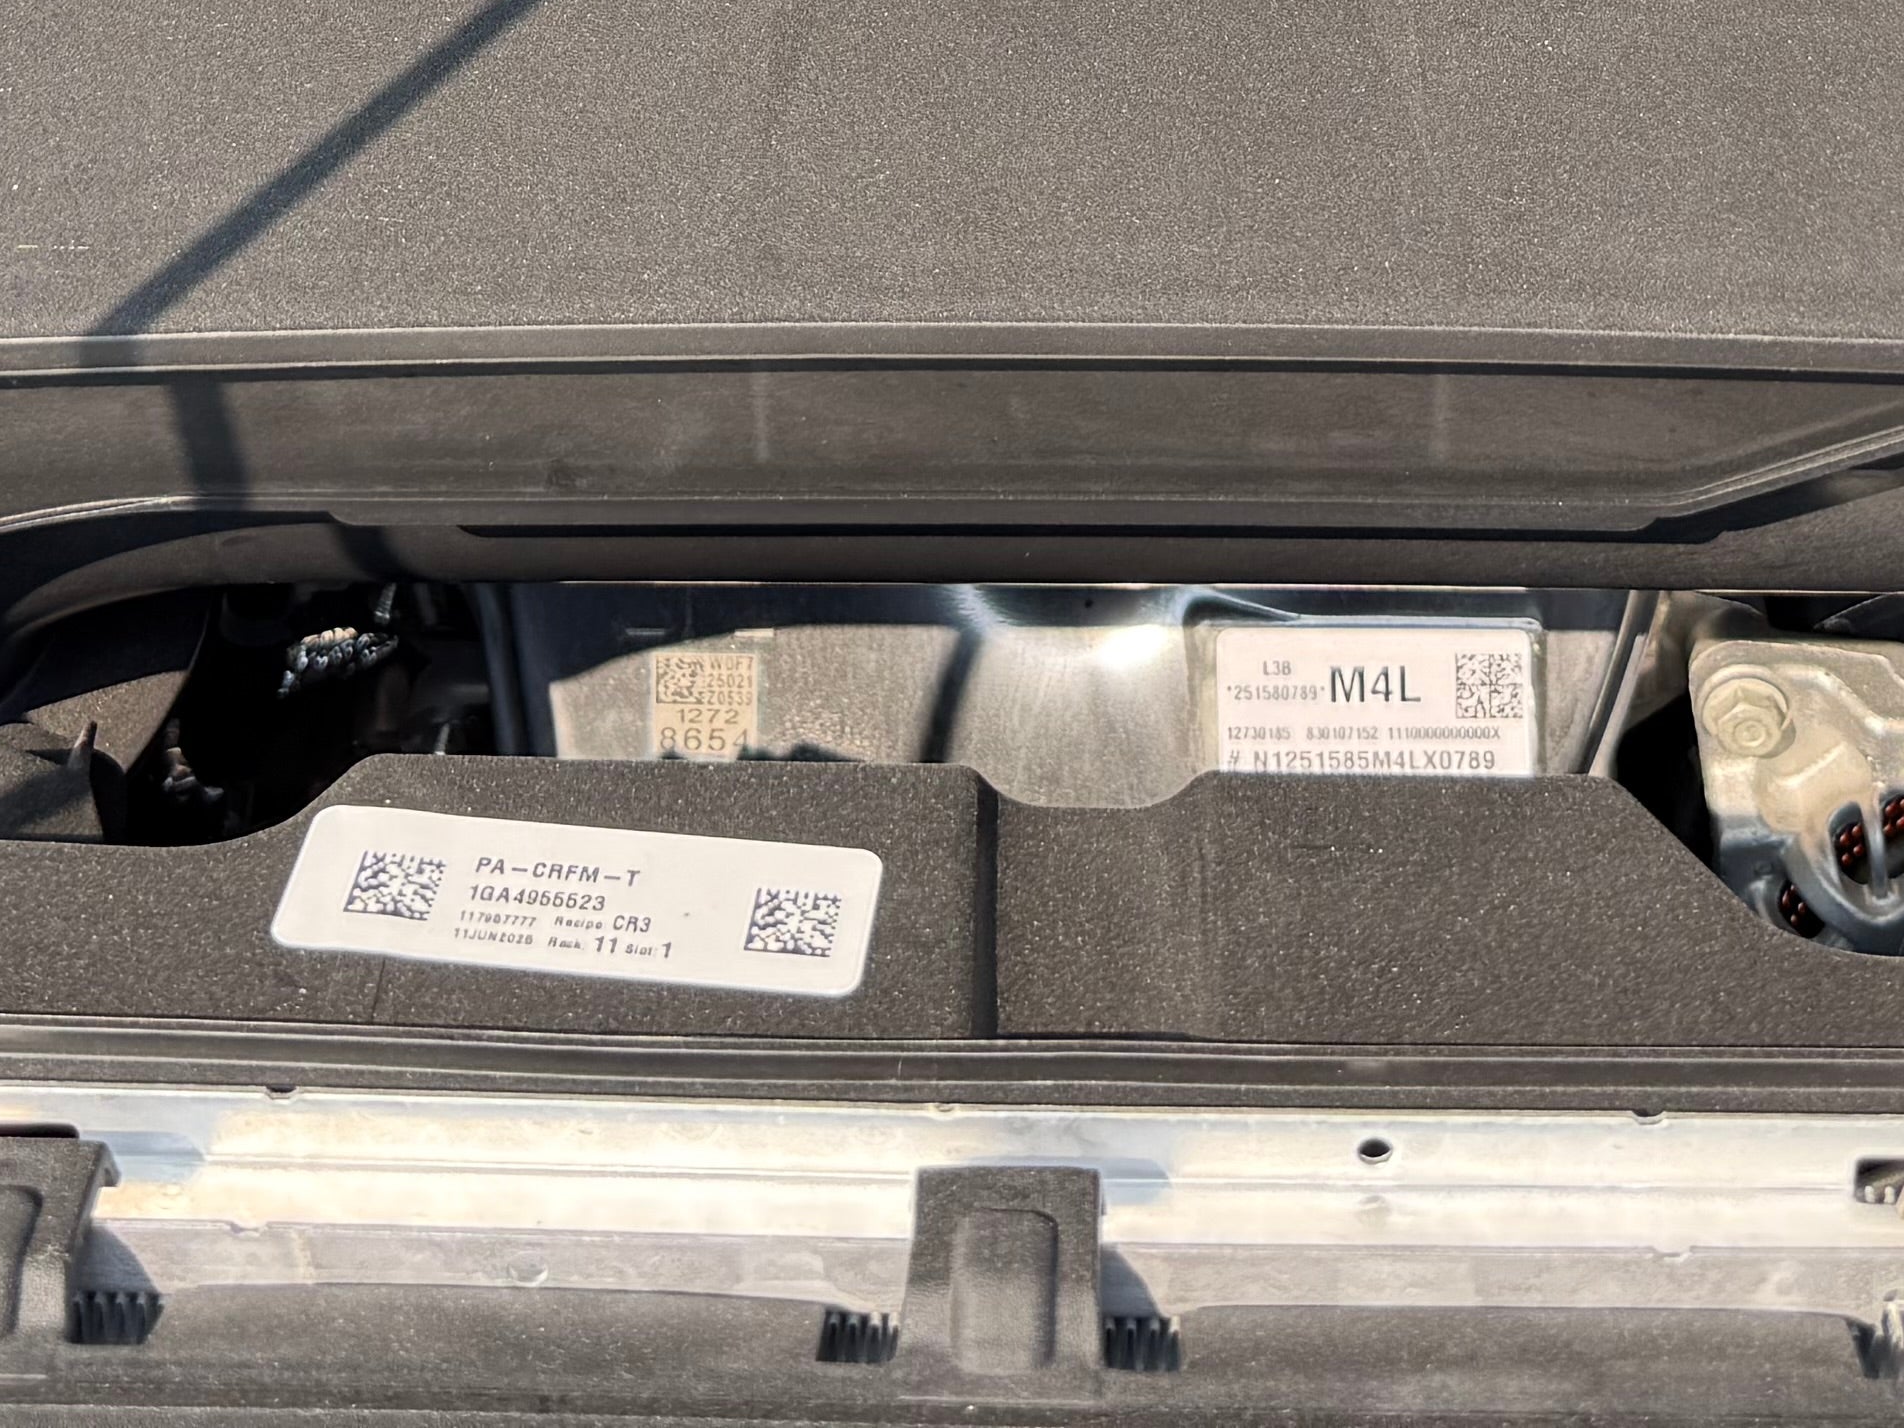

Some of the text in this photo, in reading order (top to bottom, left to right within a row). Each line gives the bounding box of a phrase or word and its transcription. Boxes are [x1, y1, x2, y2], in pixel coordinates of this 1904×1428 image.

[1330, 665, 1421, 703] M4L
[677, 709, 739, 724] 1272
[660, 727, 748, 751] 8654
[612, 915, 652, 933] CR3
[595, 935, 618, 954] 11
[662, 941, 673, 959] 1
